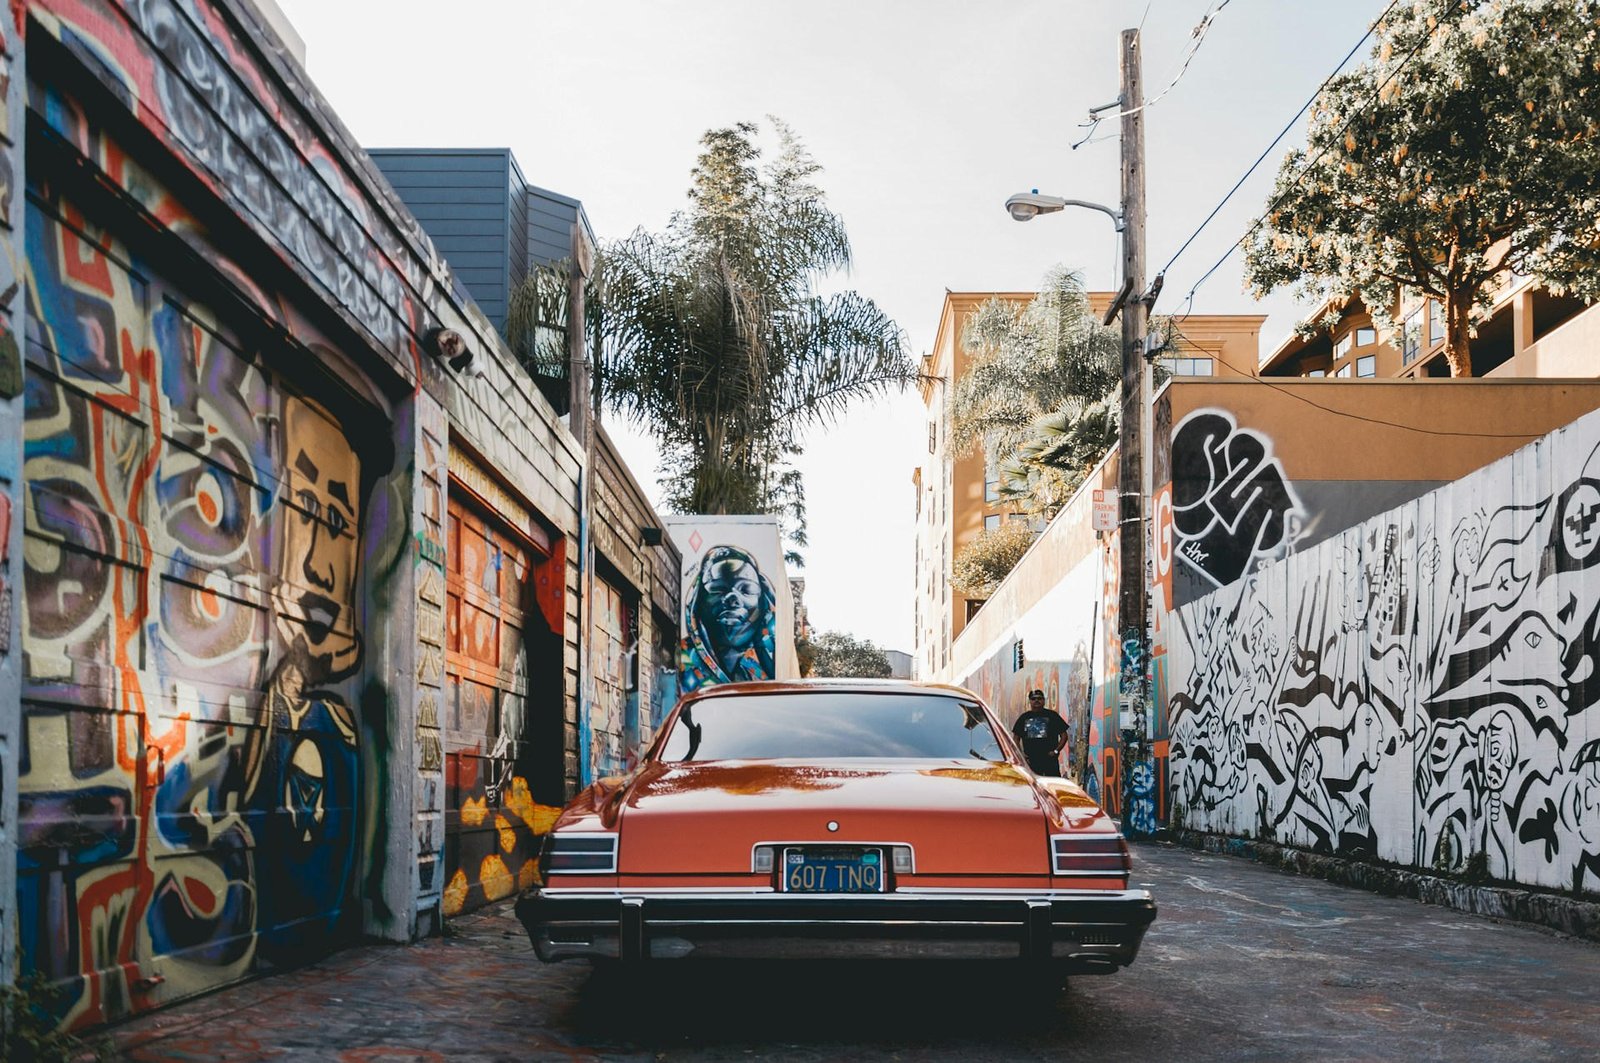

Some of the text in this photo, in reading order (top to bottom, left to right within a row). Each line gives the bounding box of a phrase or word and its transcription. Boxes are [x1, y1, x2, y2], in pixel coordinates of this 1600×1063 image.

[1093, 490, 1104, 502] NO
[1094, 503, 1116, 512] PARKING
[790, 865, 877, 889] 607 TNQ
